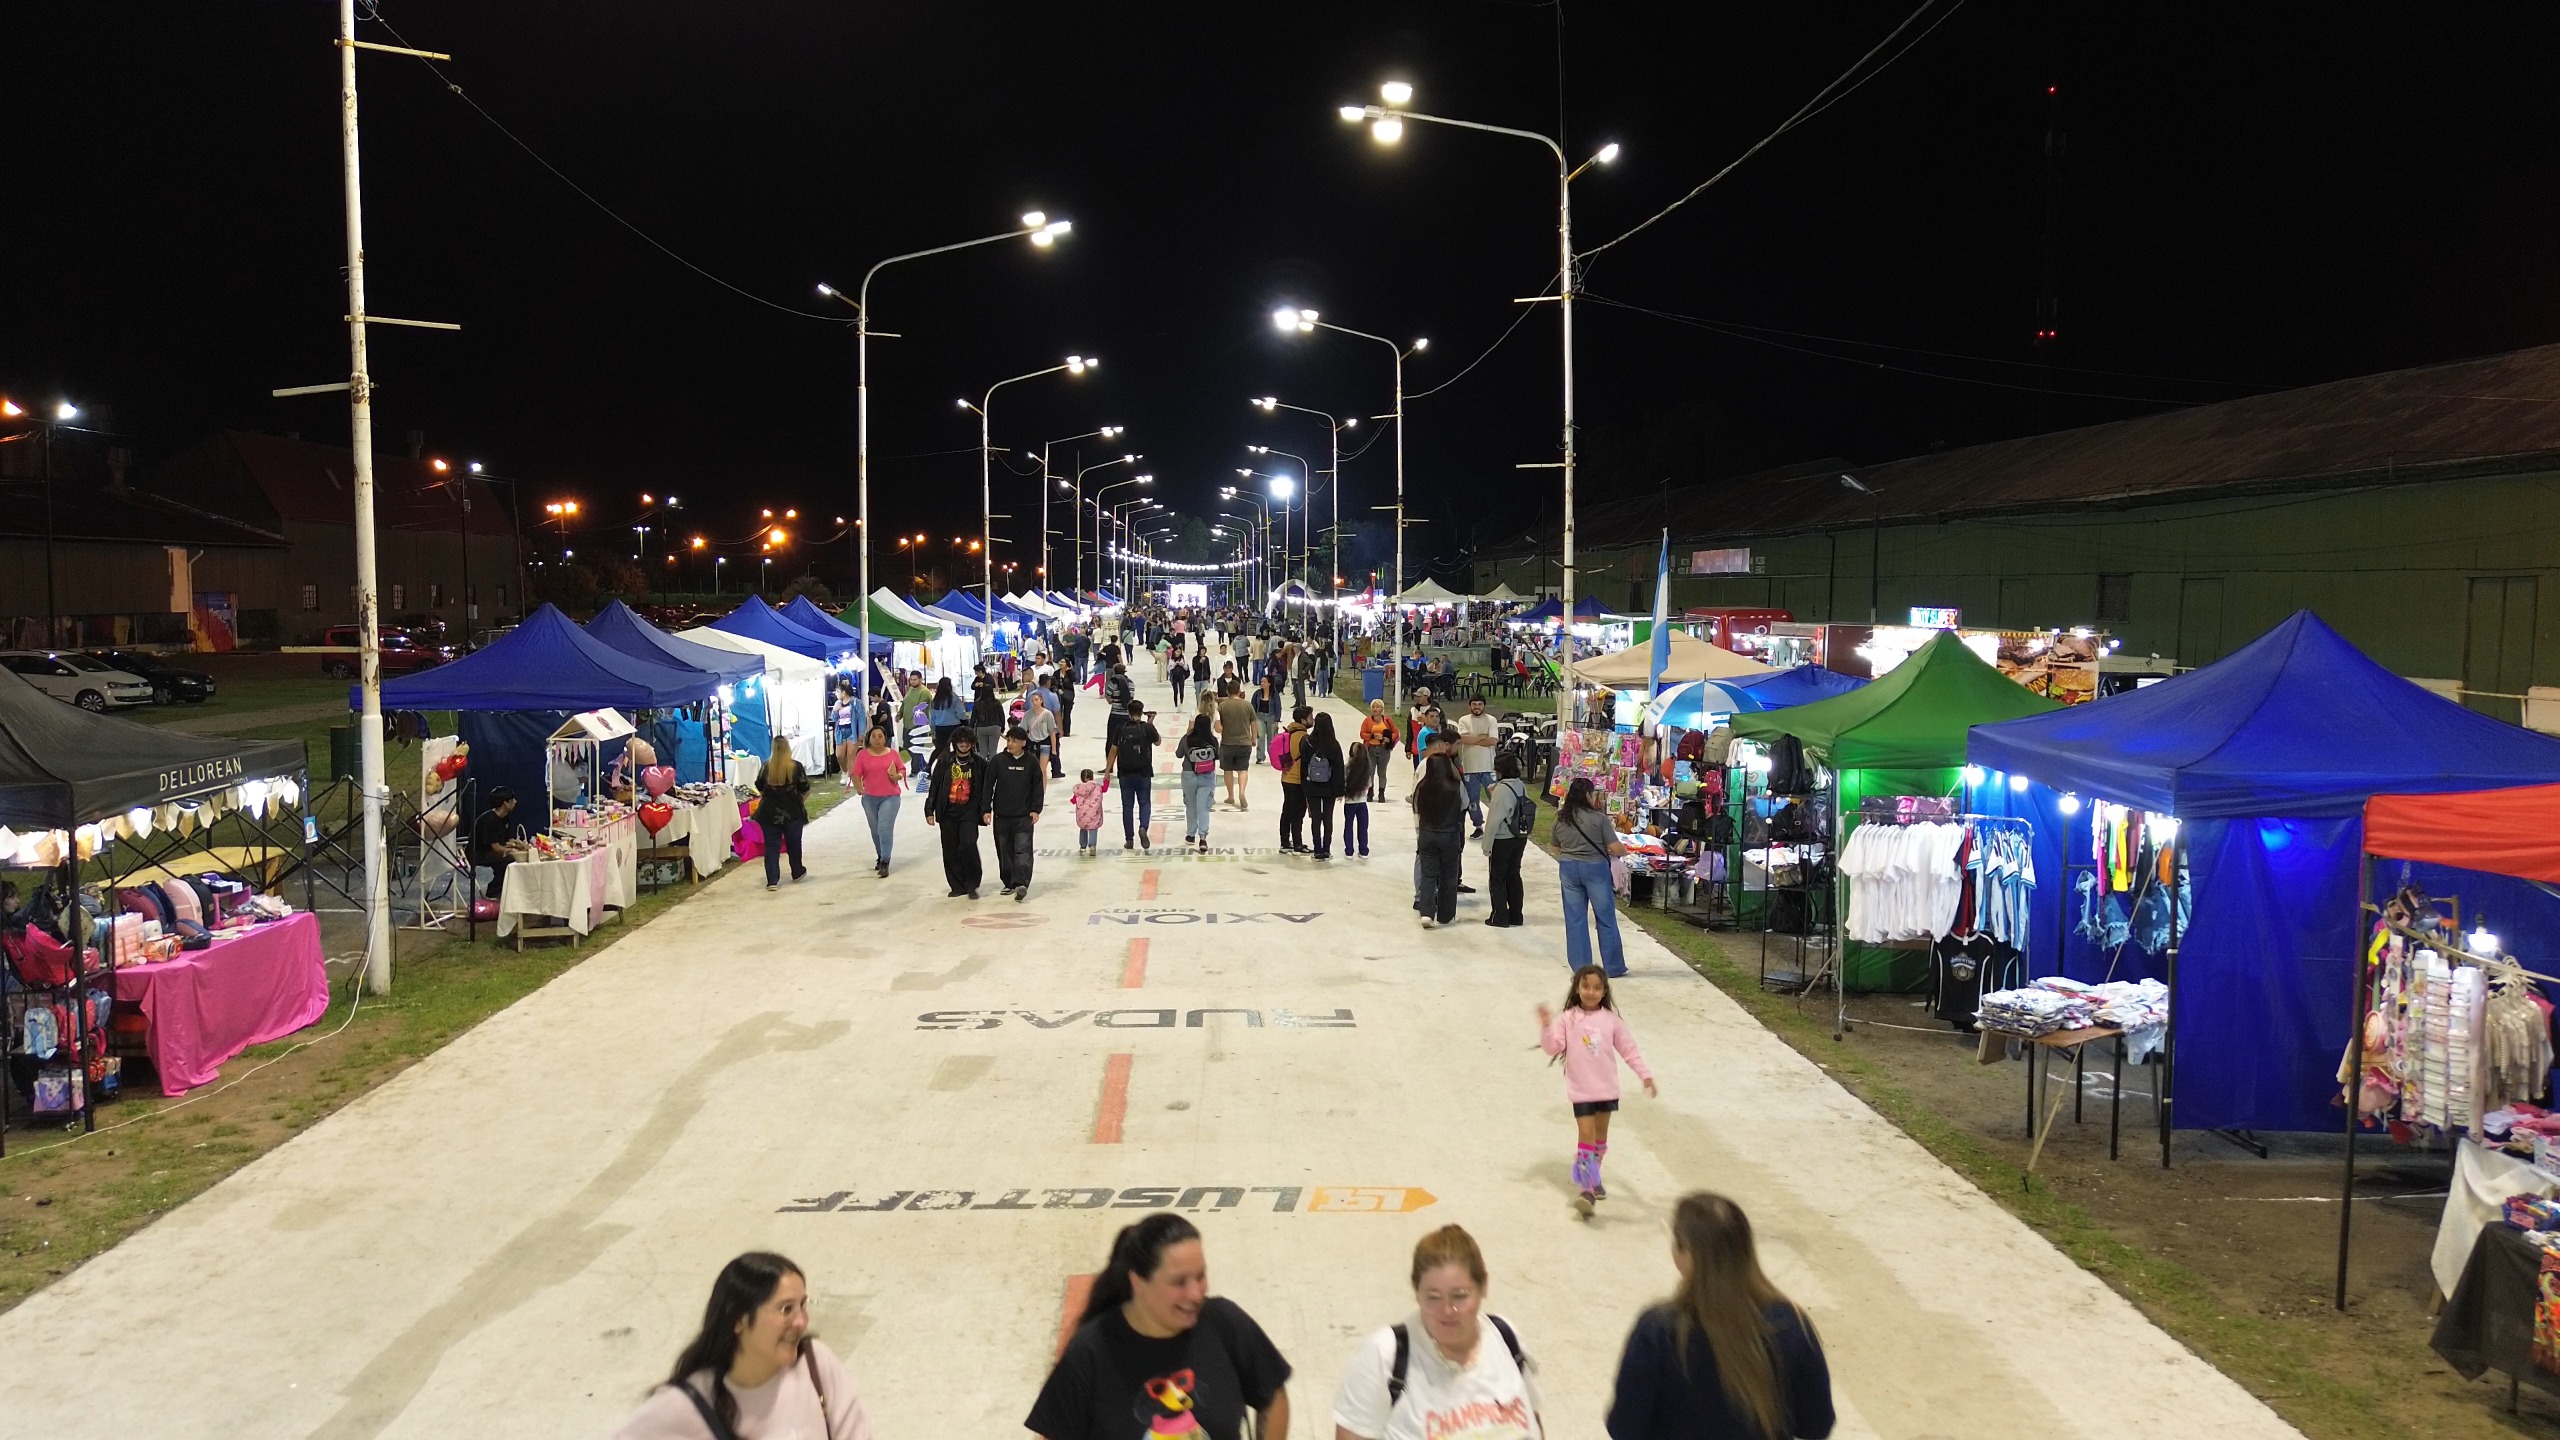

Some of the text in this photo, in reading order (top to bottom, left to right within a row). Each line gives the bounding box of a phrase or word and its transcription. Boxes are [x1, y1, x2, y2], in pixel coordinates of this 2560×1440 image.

[160, 757, 242, 791] DELLOREAN
[1087, 912, 1324, 925] AXION
[915, 1009, 1355, 1031] RUDAS
[1425, 1395, 1530, 1440] CHAMPIONS
